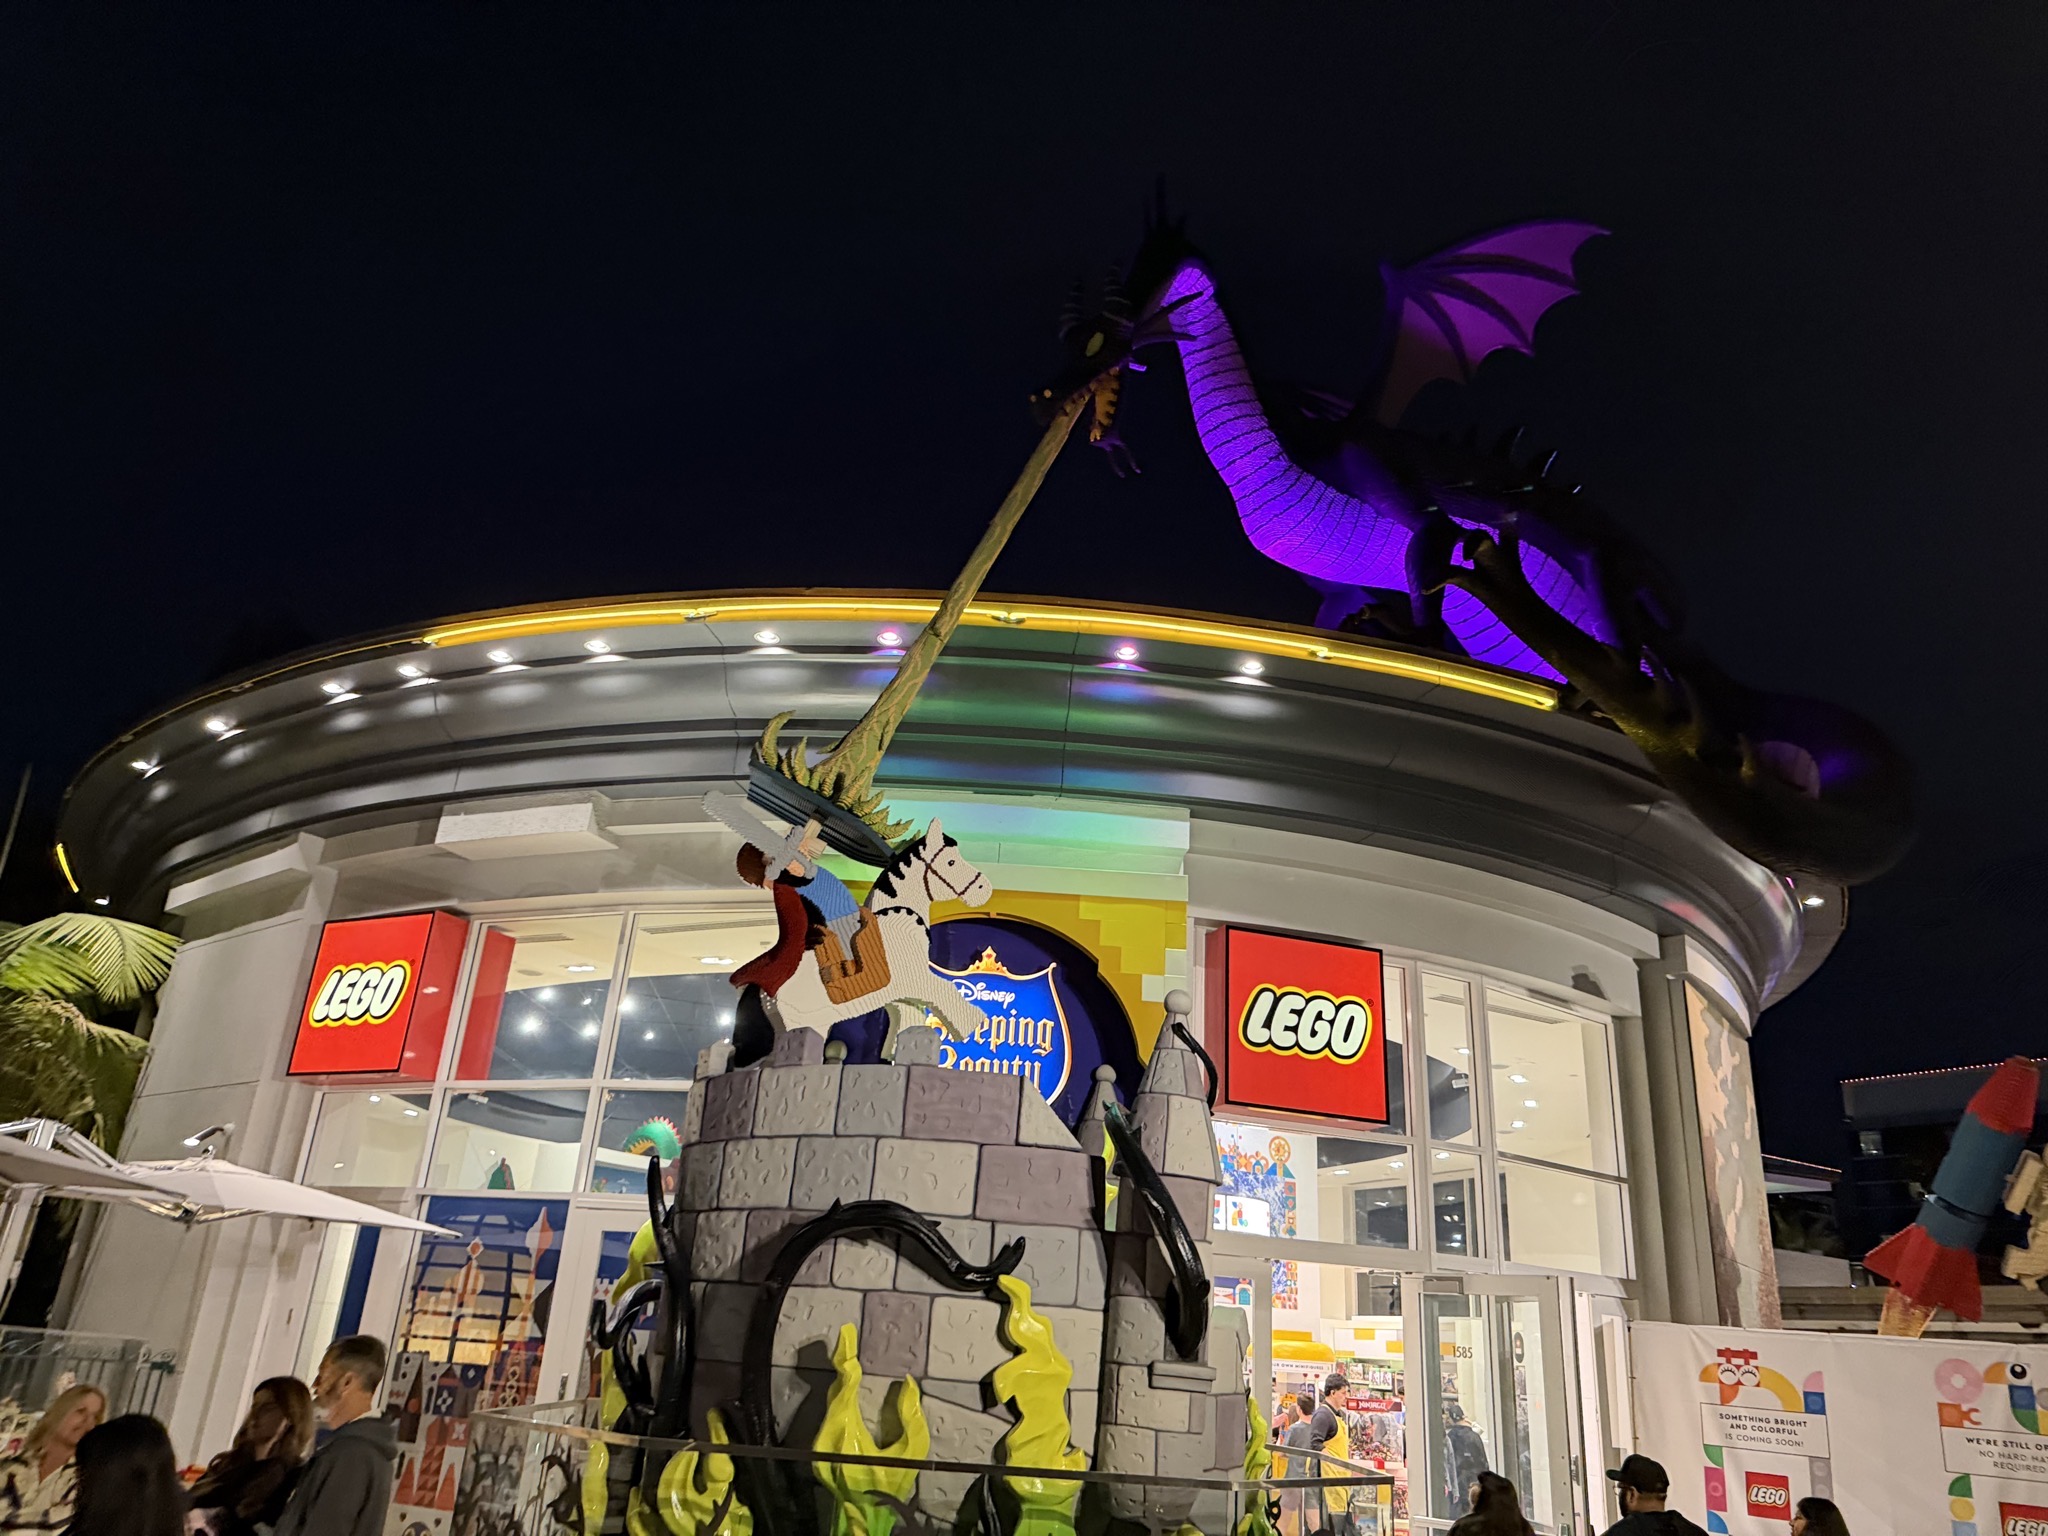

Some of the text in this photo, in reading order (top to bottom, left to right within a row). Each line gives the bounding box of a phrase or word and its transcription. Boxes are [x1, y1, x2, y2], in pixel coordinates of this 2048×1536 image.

[311, 963, 408, 1024] LEGO
[1241, 986, 1369, 1061] LEGO
[1452, 1346, 1473, 1359] 1585
[1719, 1413, 1807, 1428] SOMETHING BRIGHT
[1730, 1423, 1798, 1436] AND COLORFUL
[1737, 1434, 1772, 1444] COMING
[1775, 1438, 1804, 1448] SOON!
[1965, 1437, 1999, 1447] WE'RE
[2002, 1440, 2031, 1450] STILL
[1979, 1450, 1995, 1459] NO
[1998, 1452, 2027, 1461] HARD
[1993, 1461, 2047, 1474] REQUIRED
[1749, 1485, 1788, 1506] LEGO
